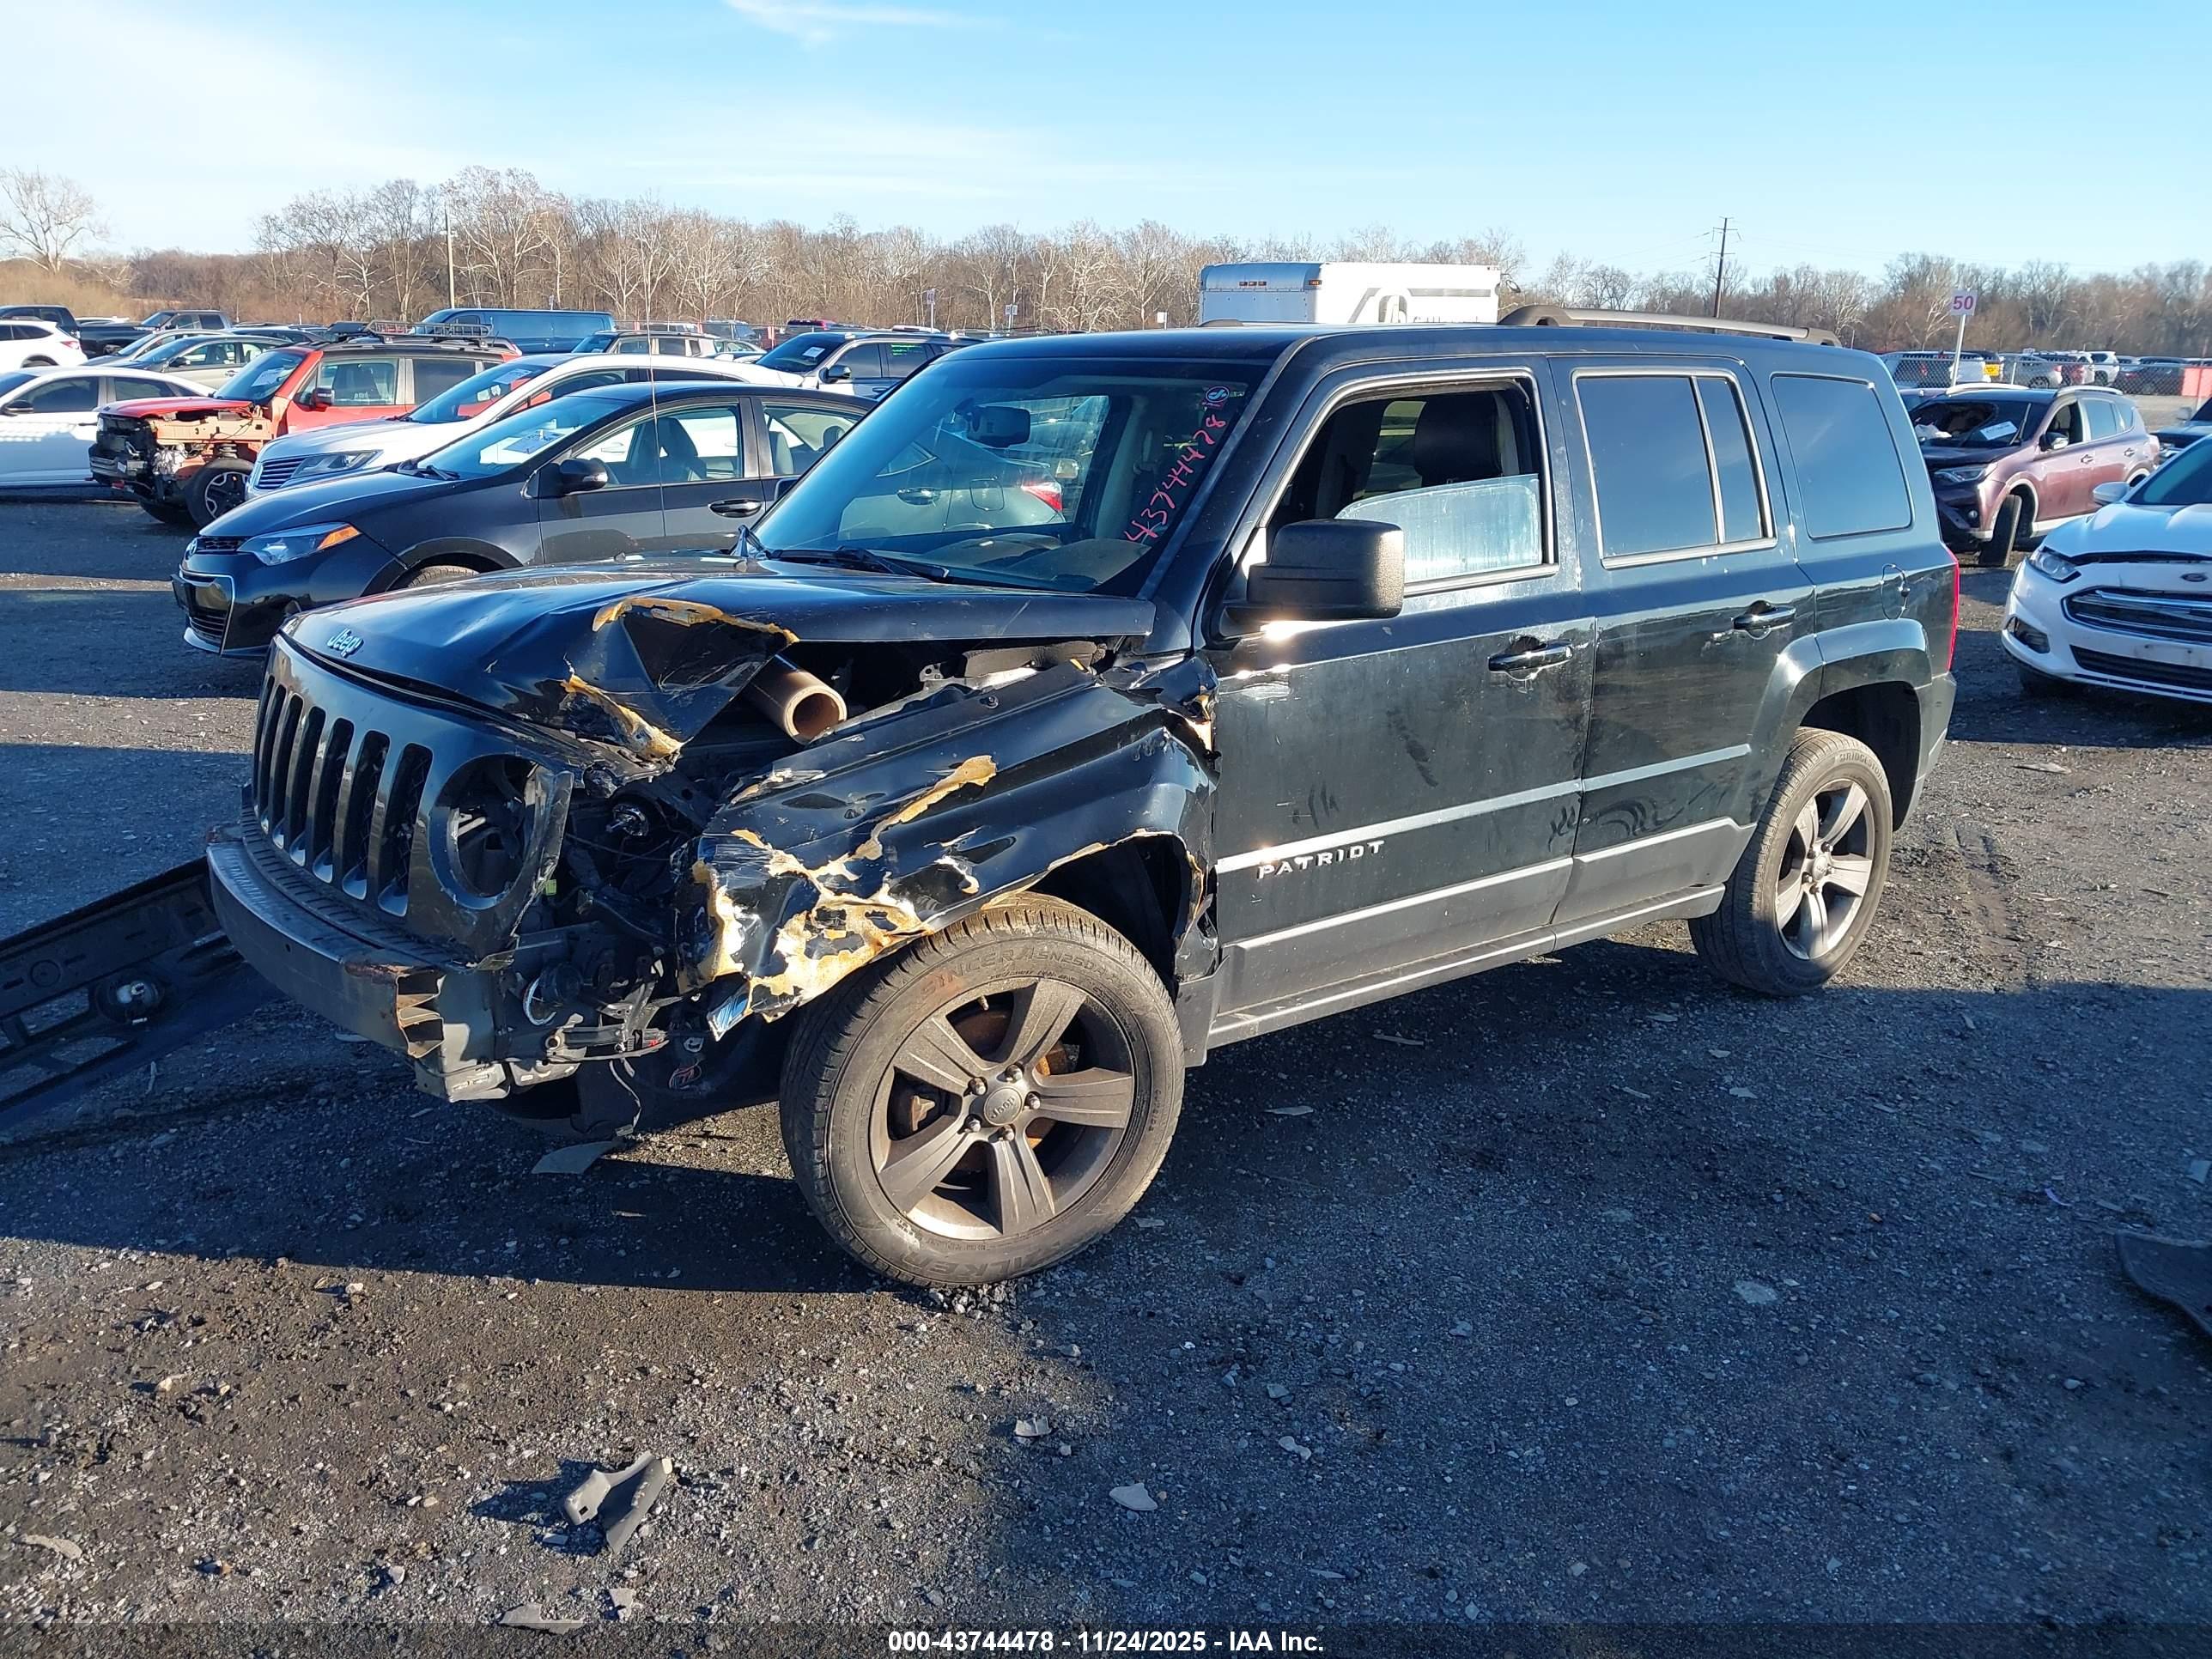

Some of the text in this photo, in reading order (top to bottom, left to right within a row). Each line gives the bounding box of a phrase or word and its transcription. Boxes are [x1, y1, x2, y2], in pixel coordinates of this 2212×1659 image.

[1954, 295, 1974, 310] 50
[1123, 414, 1227, 542] 43744478
[327, 628, 364, 659] Jeep
[1257, 840, 1385, 880] PATRIOT
